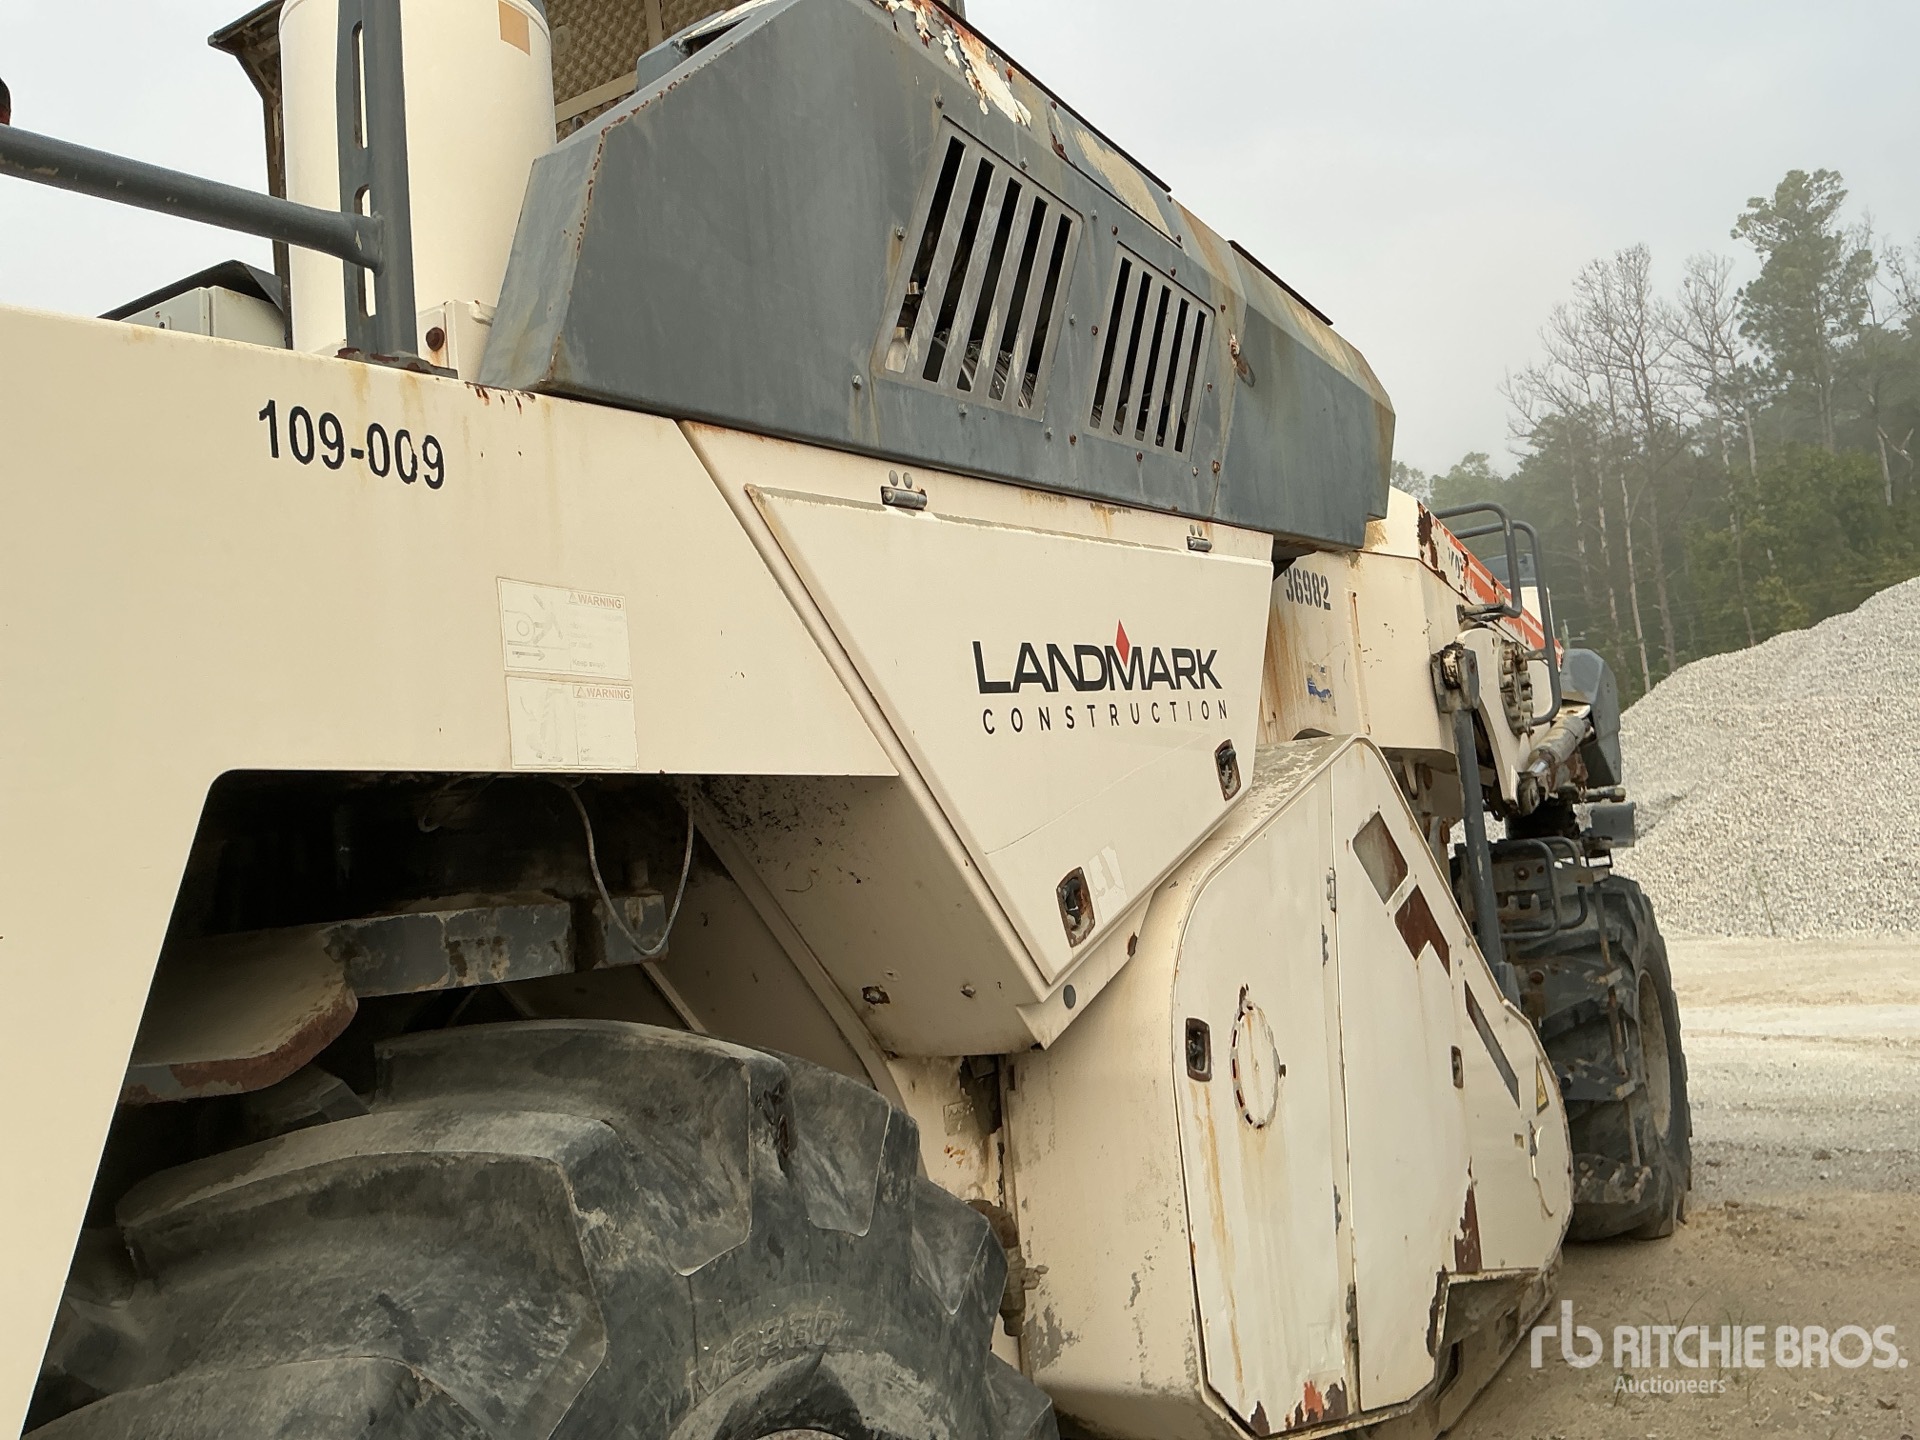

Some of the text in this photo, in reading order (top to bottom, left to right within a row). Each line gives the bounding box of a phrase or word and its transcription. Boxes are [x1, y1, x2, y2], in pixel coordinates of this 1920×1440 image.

[257, 399, 445, 490] 109-009
[577, 593, 622, 609] WARNING
[1283, 567, 1331, 611] 36982
[971, 640, 1223, 694] LANDMARK
[586, 687, 631, 700] WARNING
[982, 699, 1228, 735] CONSTRUCTION
